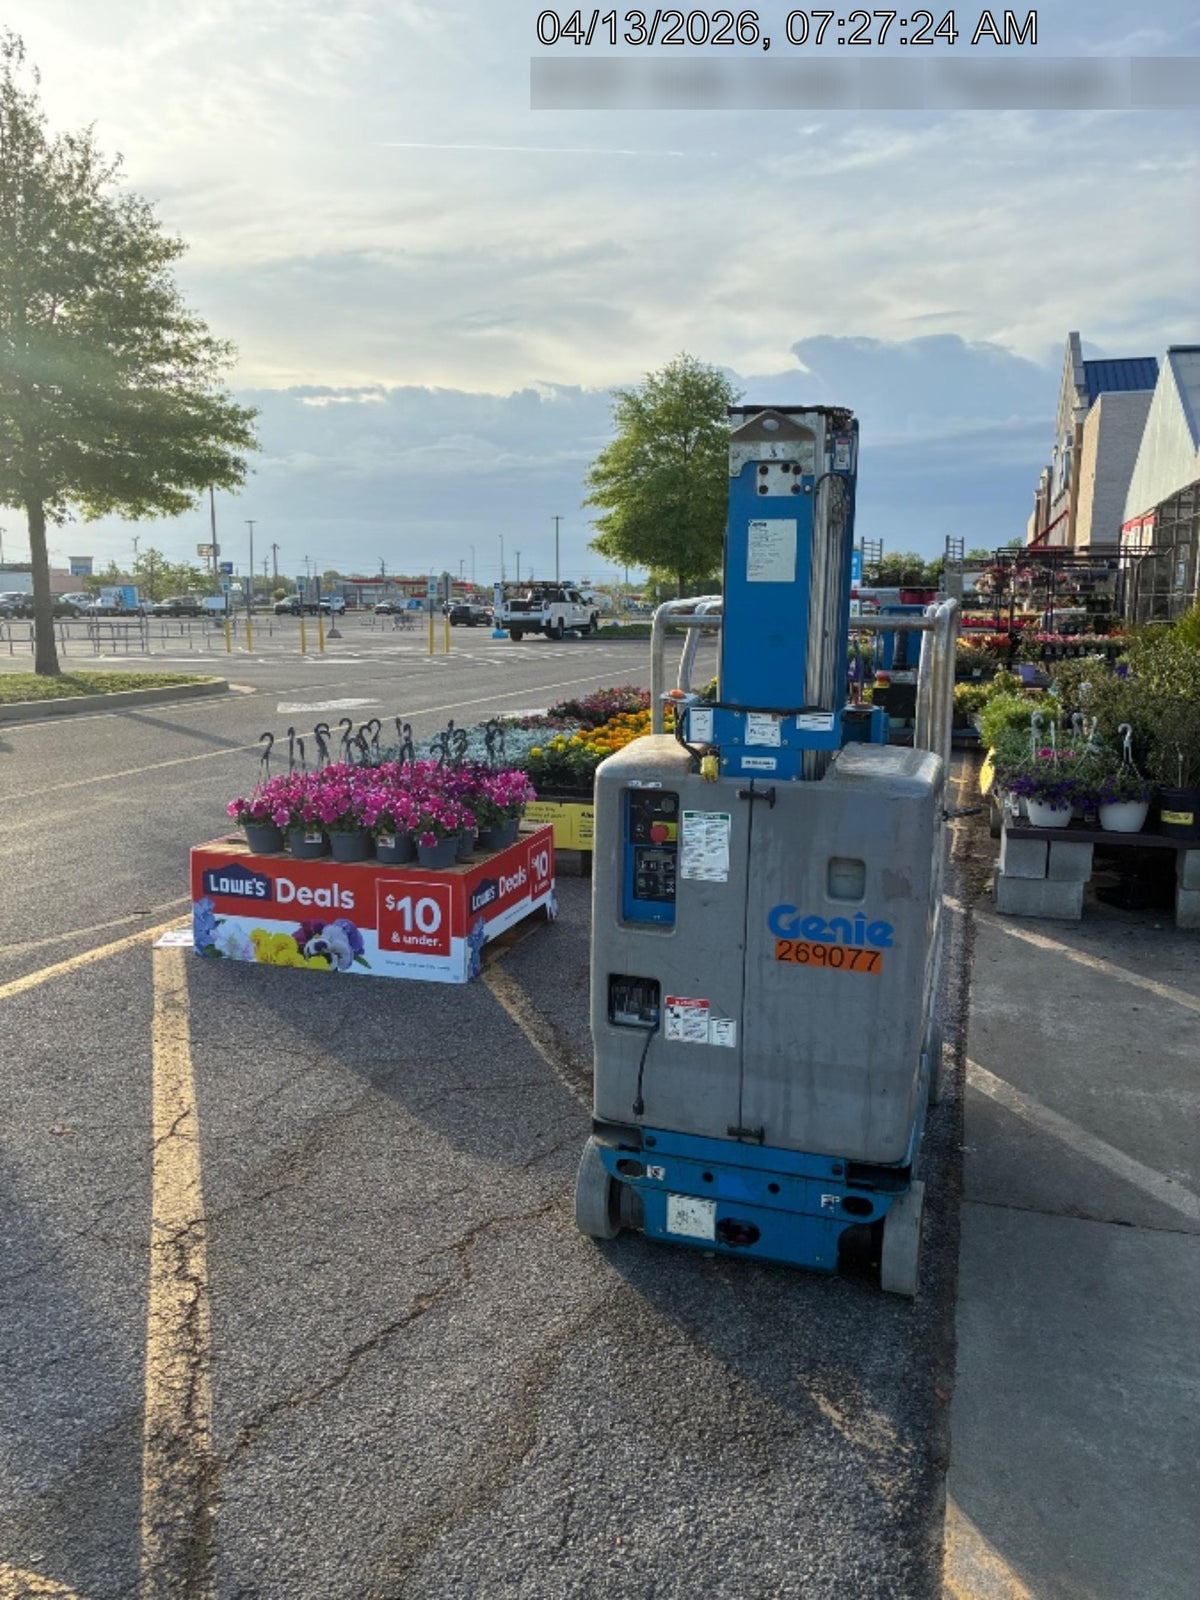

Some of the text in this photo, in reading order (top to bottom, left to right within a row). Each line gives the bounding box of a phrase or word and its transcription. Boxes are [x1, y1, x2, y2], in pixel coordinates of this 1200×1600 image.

[275, 878, 355, 909] Deals
[499, 865, 527, 898] Deals
[385, 893, 442, 934] $10
[768, 904, 894, 948] Genie
[391, 931, 442, 947] & under.
[778, 940, 880, 971] 269077
